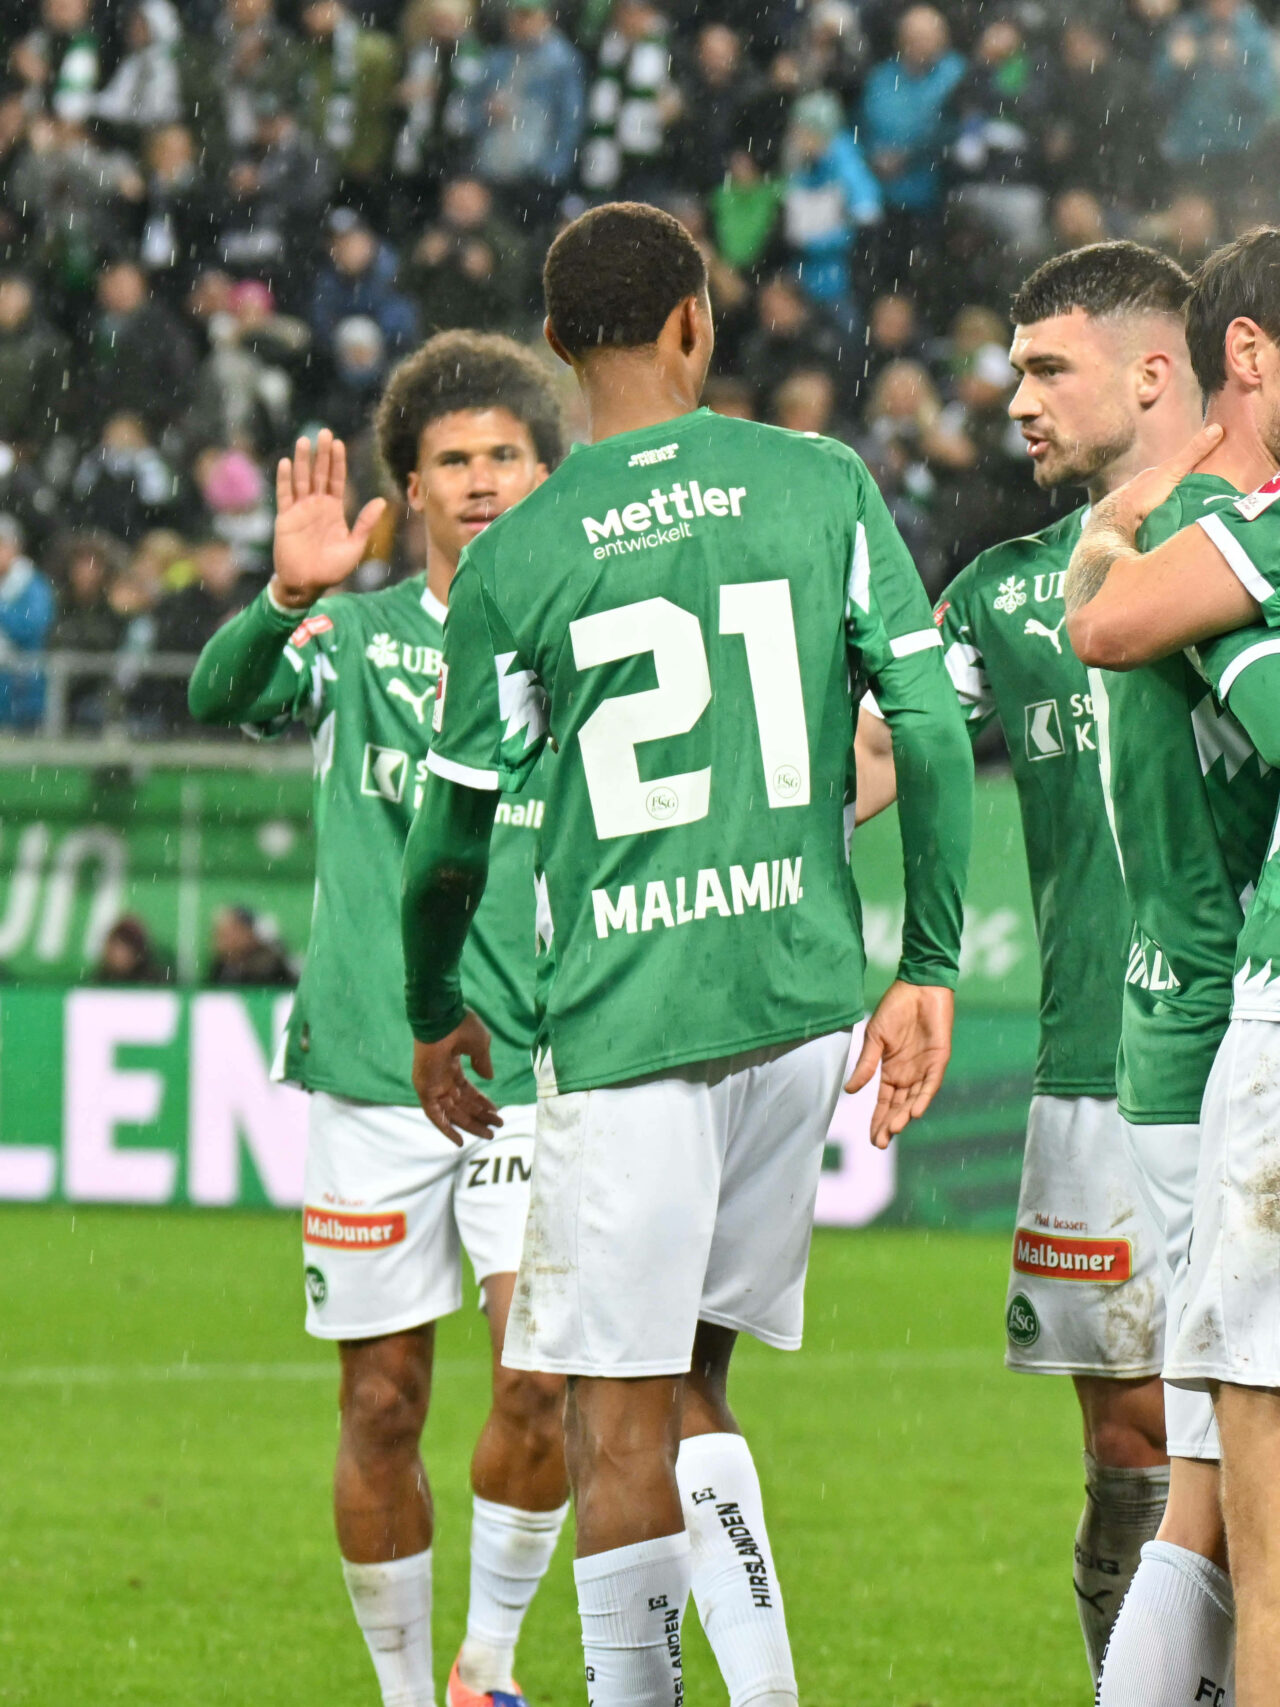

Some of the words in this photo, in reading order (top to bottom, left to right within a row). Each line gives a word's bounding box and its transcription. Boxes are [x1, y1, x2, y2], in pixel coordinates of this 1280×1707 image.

[581, 480, 747, 545] Mettler
[593, 521, 692, 560] entwickelt
[569, 578, 811, 840] 21
[592, 856, 803, 939] MALAMIN
[306, 1215, 395, 1243] Malbuner
[1017, 1239, 1116, 1271] Malbuner
